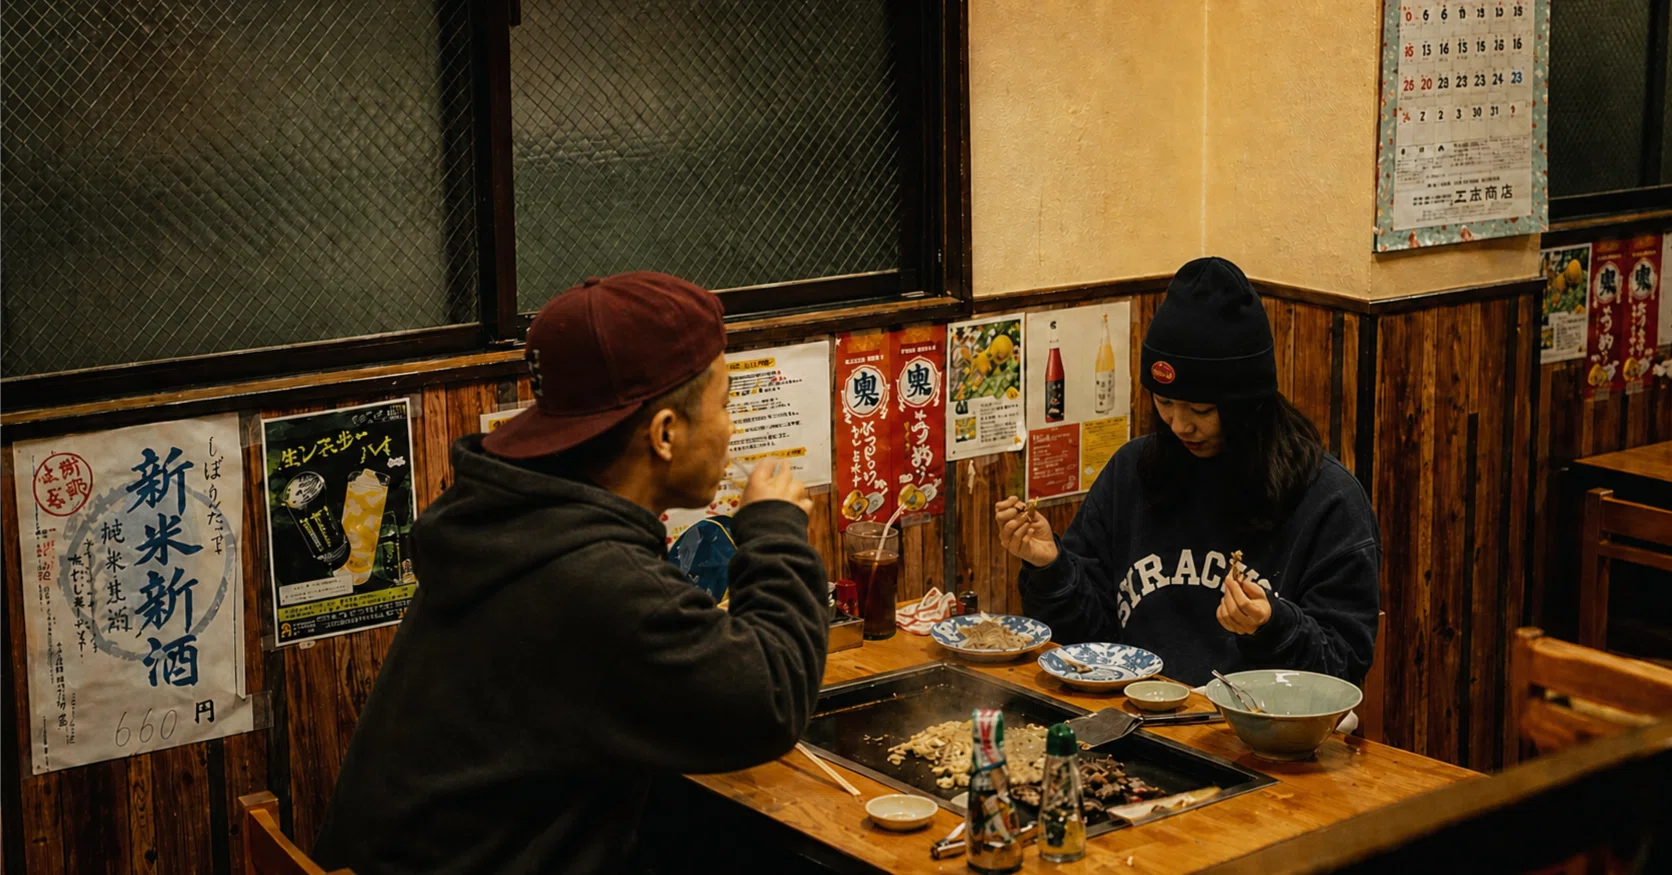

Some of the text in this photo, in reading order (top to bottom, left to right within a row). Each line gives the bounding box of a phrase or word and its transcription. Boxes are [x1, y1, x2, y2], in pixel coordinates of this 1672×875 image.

[1420, 78, 1433, 90] 20
[1455, 75, 1468, 88] 23
[1474, 74, 1486, 87] 23
[1472, 107, 1482, 117] 30
[126, 447, 204, 687] 新米新酒
[1117, 549, 1279, 629] SYRAC
[194, 699, 216, 725] 円
